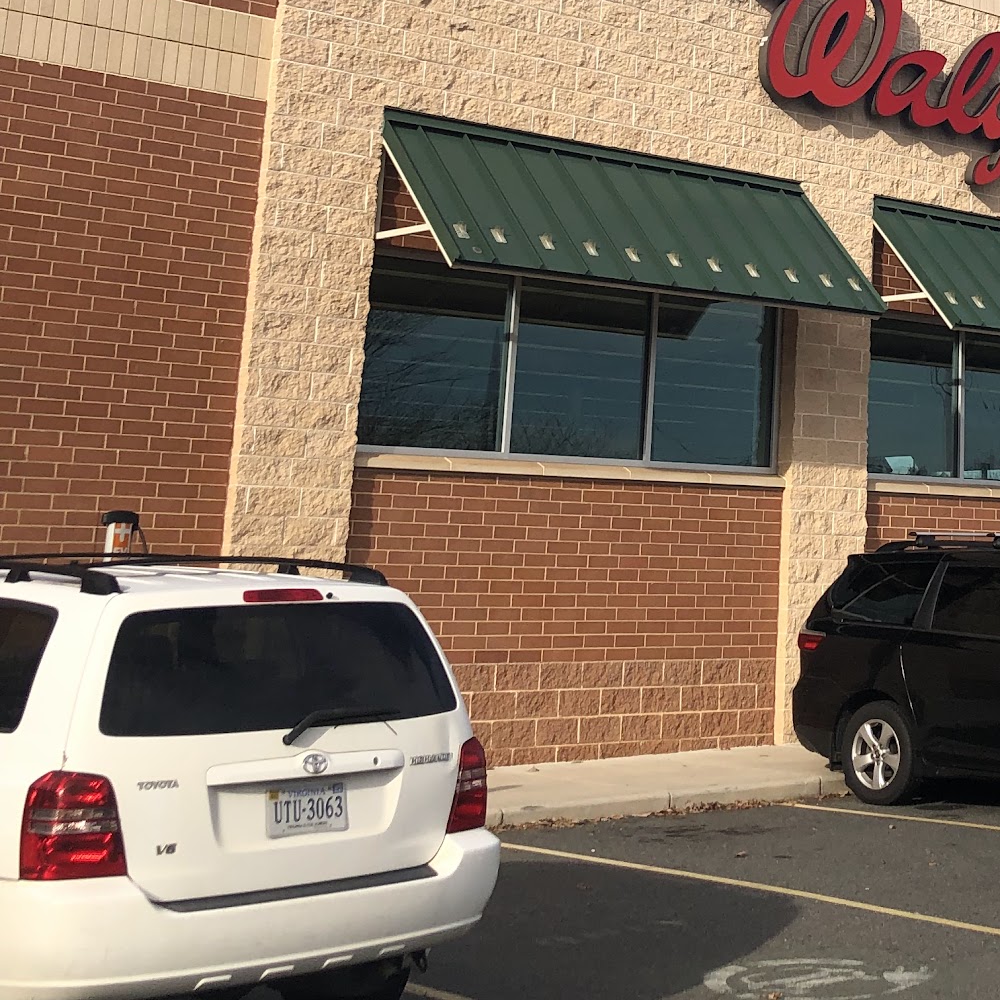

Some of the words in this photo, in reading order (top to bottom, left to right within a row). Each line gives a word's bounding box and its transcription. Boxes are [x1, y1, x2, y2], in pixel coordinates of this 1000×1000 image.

[137, 779, 179, 791] TOYOTA
[289, 787, 326, 798] VIRGINIA
[156, 843, 177, 856] V6
